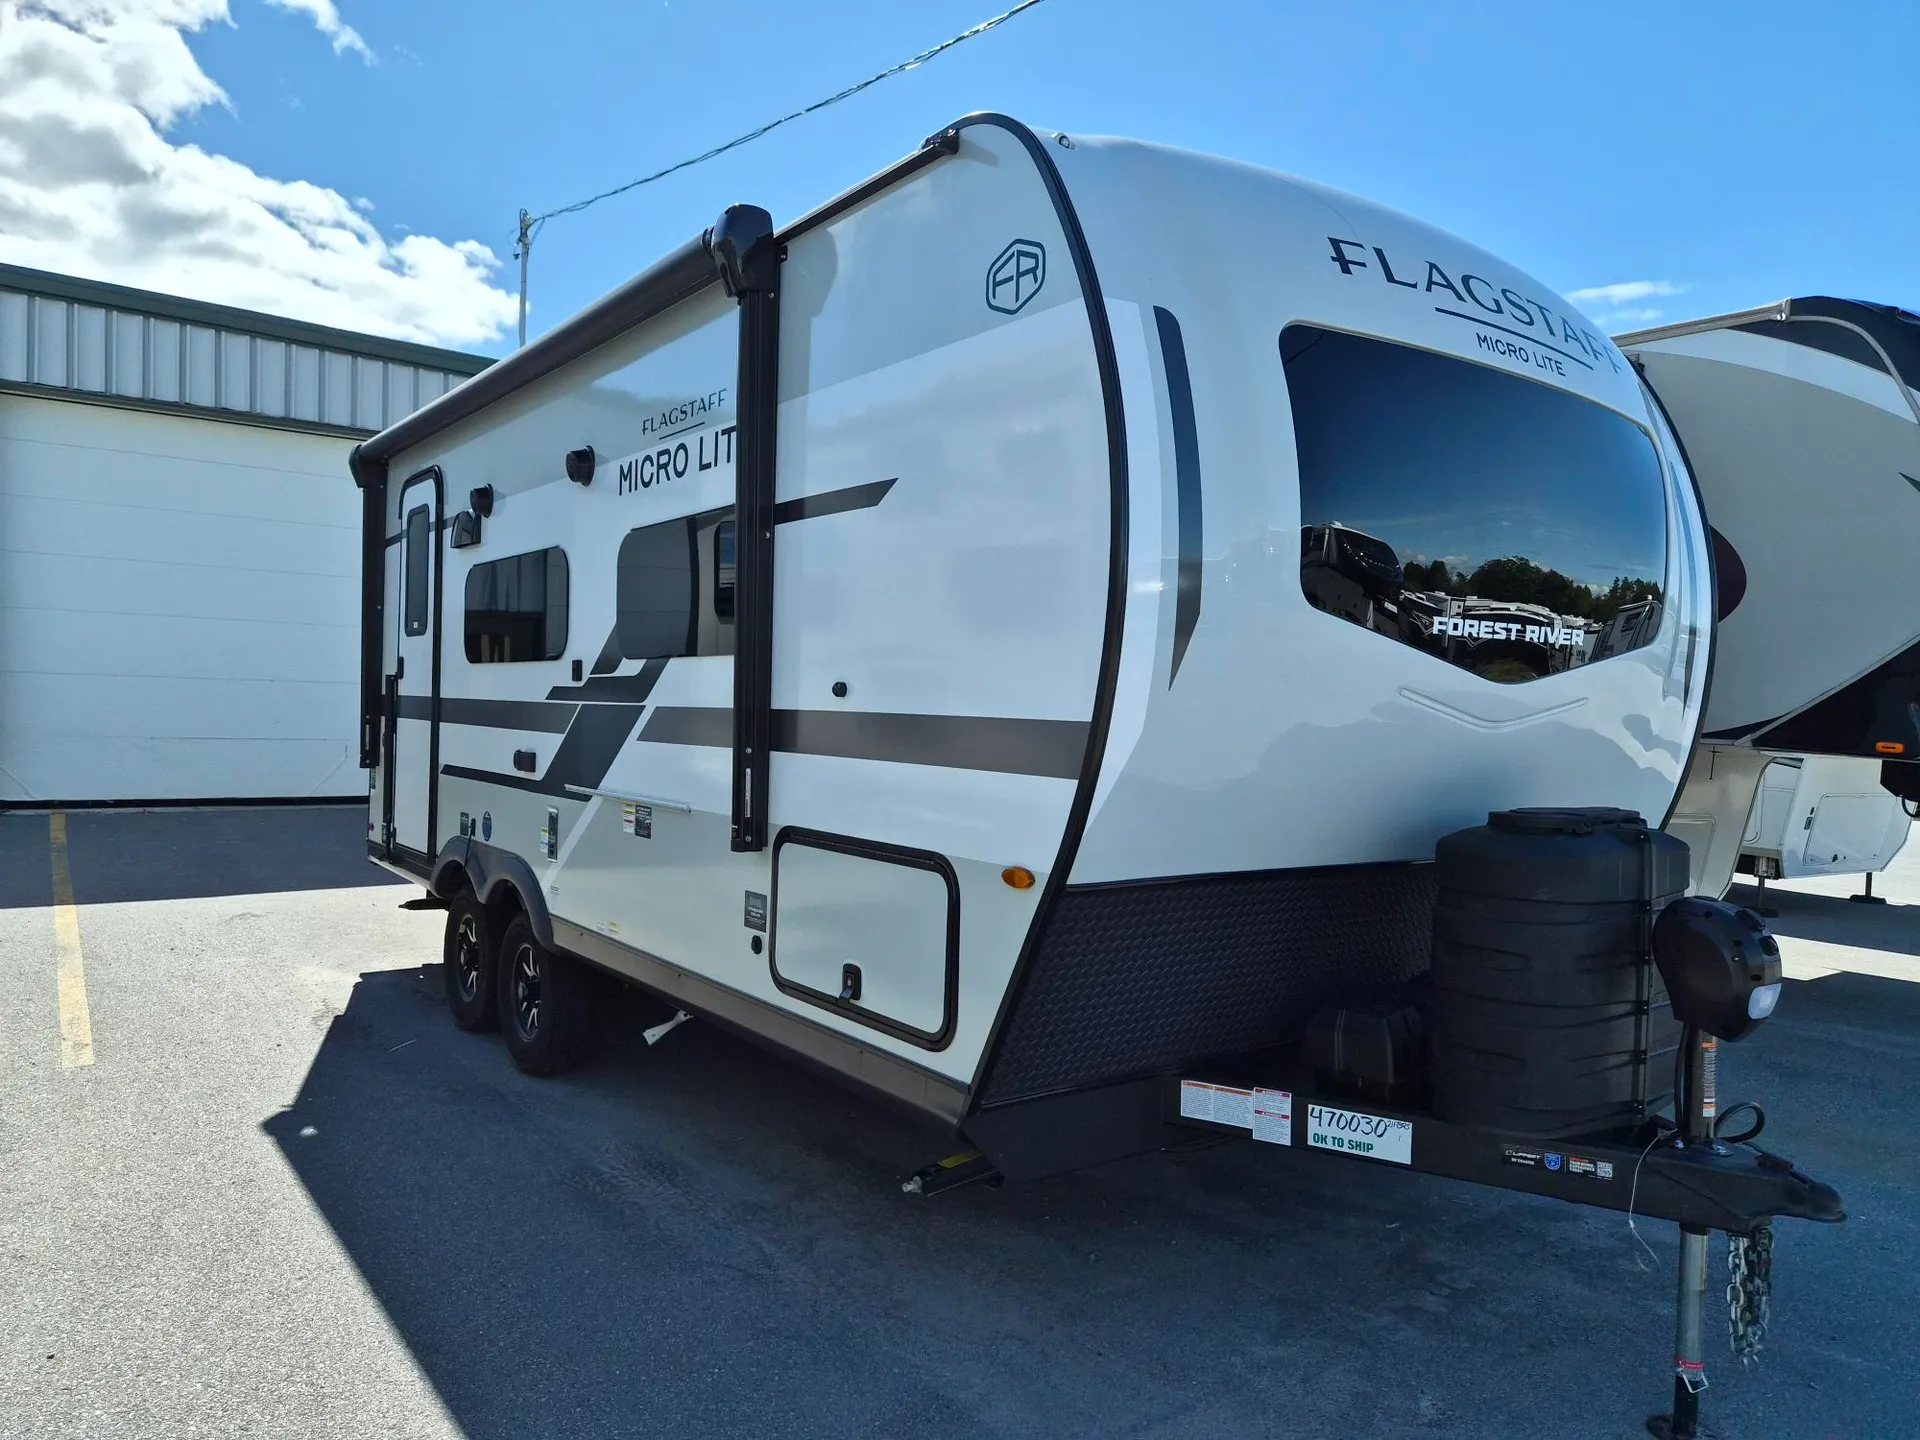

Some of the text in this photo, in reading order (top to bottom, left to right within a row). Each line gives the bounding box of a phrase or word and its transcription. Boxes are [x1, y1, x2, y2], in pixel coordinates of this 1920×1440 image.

[1326, 236, 1624, 376] FLAGSTAFF
[1475, 331, 1567, 378] MICRO LITE
[641, 388, 728, 436] FLAGSTAFF
[618, 424, 737, 497] MICRO LIT
[1432, 616, 1585, 647] FOREST RIVER
[1309, 1106, 1387, 1138] 470030
[1312, 1132, 1374, 1153] OK TO SHIP
